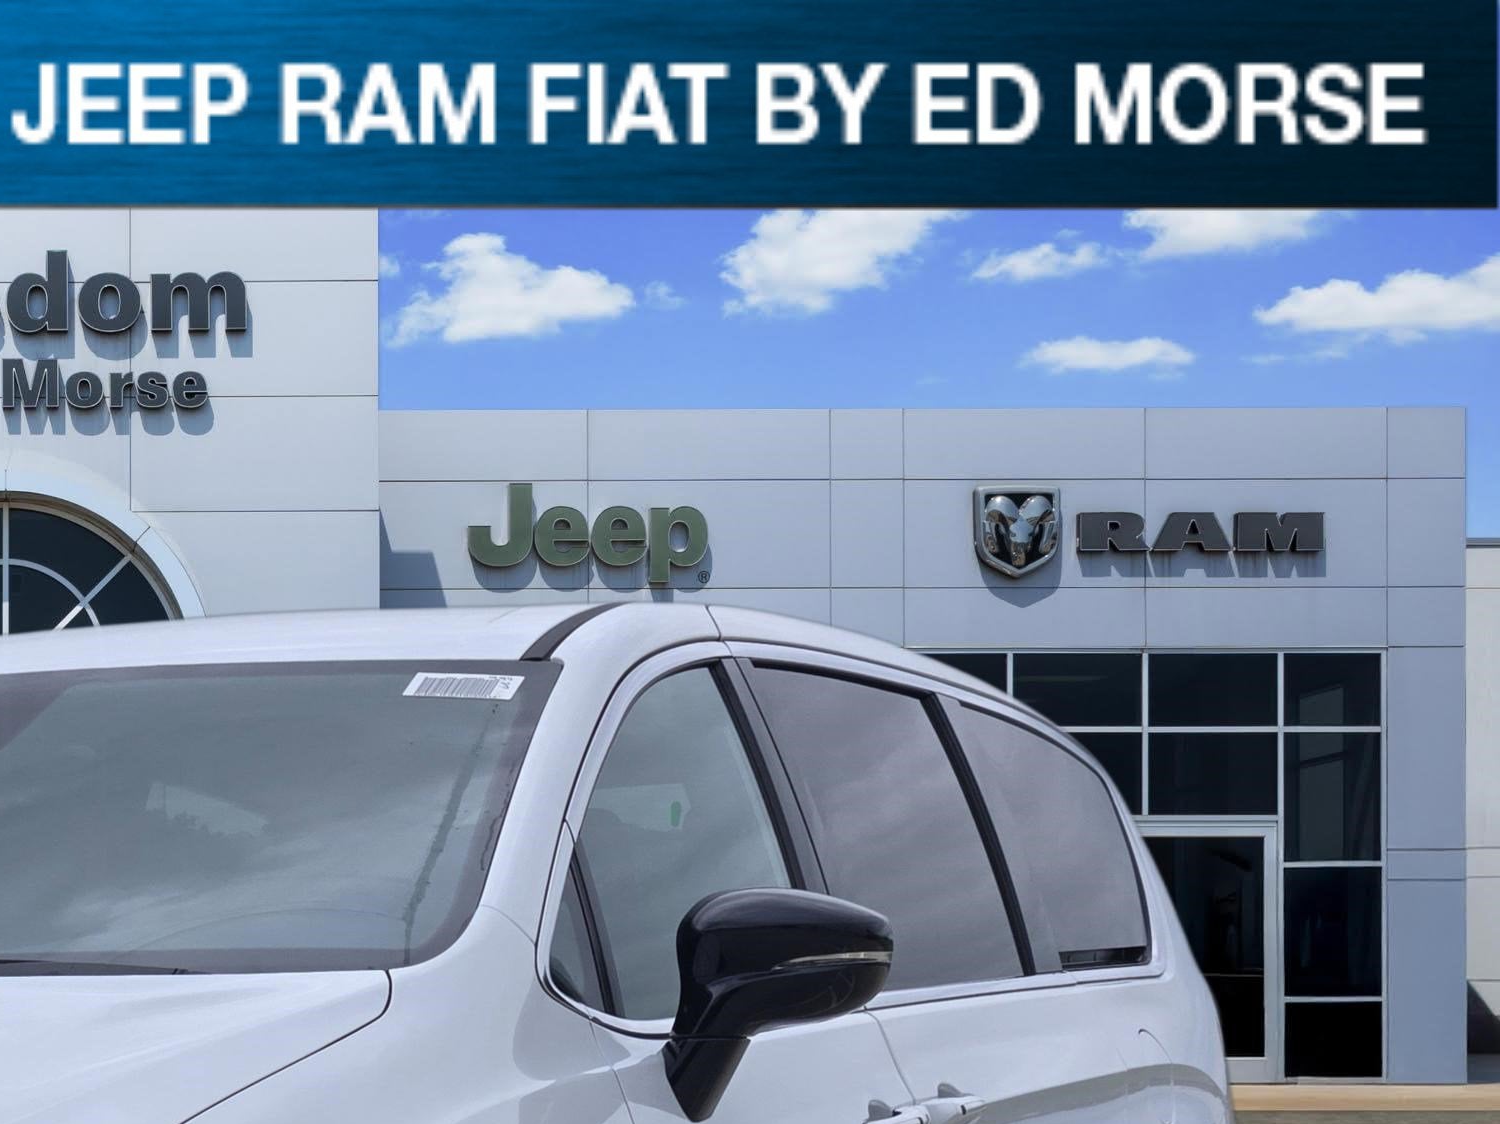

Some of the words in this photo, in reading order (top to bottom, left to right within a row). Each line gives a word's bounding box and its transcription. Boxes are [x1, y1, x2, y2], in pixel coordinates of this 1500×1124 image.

[2, 358, 209, 409] Morse
[467, 482, 709, 583] Jeep
[1076, 512, 1325, 552] RAM
